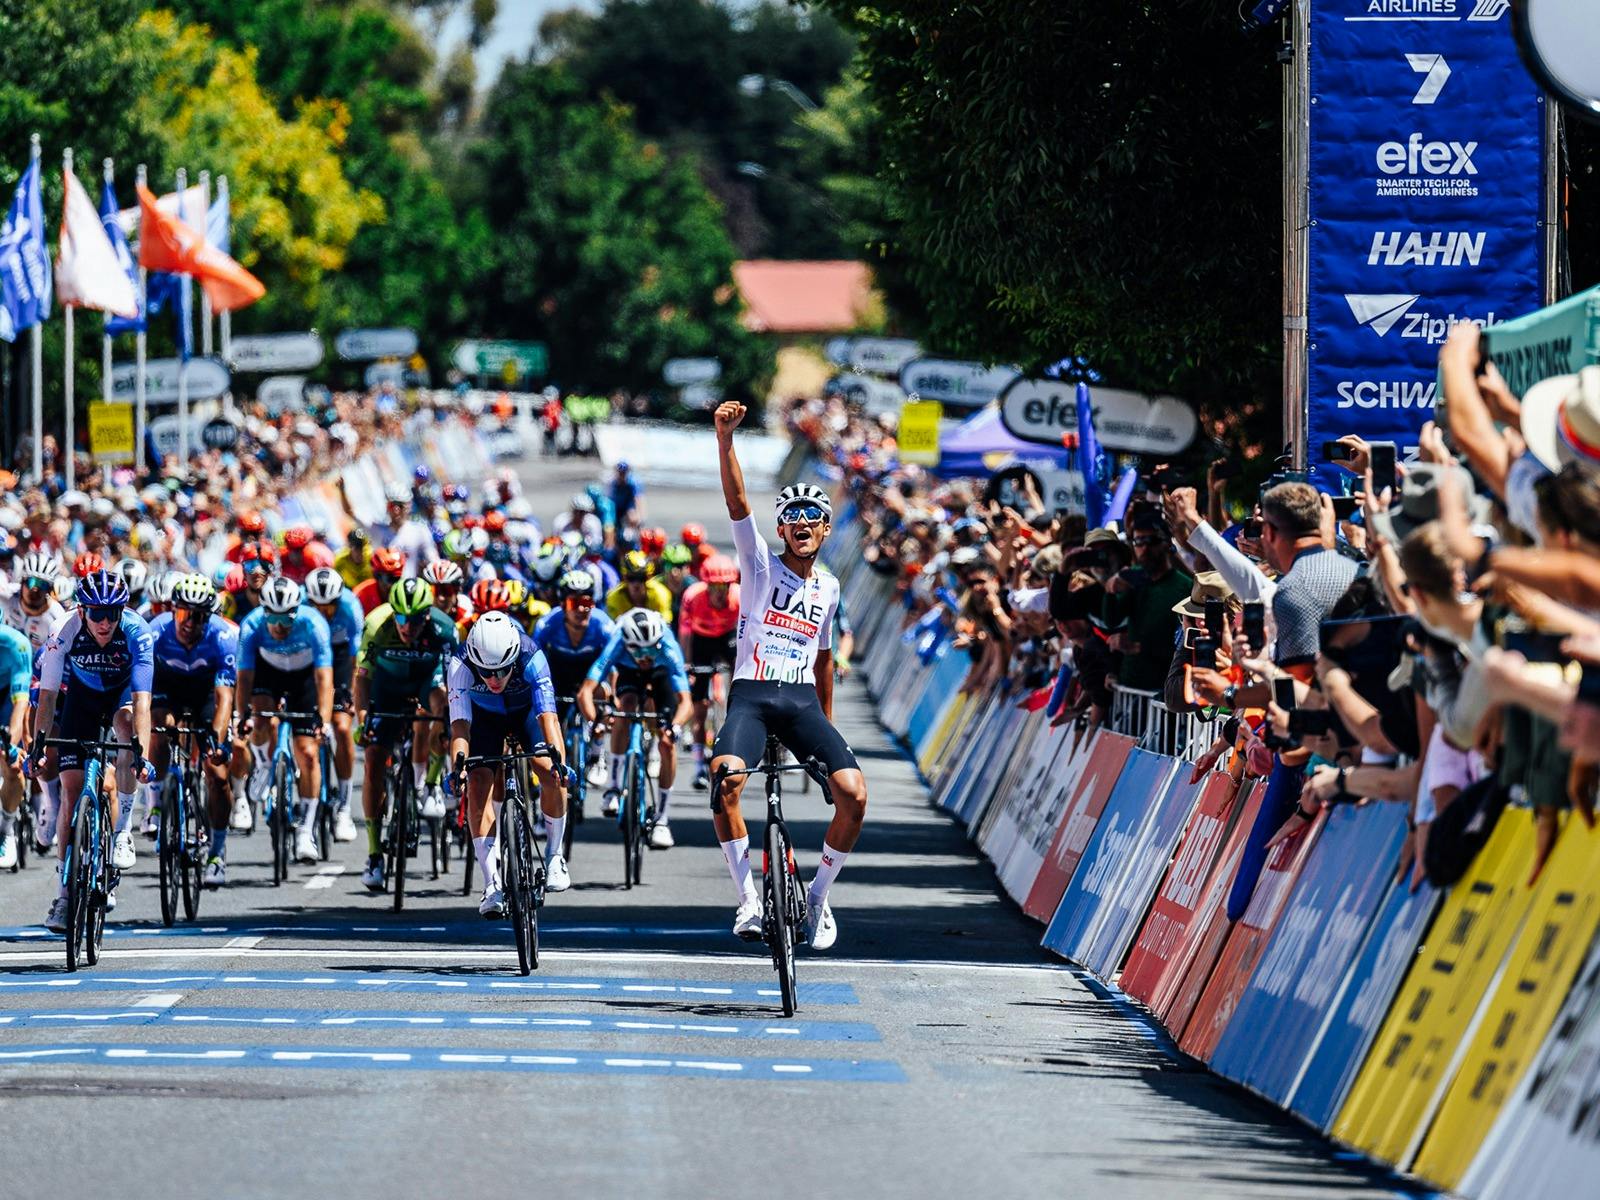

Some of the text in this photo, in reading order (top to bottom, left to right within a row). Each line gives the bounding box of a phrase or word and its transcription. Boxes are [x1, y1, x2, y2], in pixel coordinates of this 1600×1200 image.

[1376, 132, 1479, 175] efex
[1376, 179, 1470, 188] SMARTER TECH FOR
[1376, 187, 1479, 196] AMBITIOUS BUSINESS
[1367, 231, 1487, 266] HAHN
[1337, 381, 1437, 409] SCHW
[771, 586, 823, 625] UAE
[766, 611, 818, 638] Emirates
